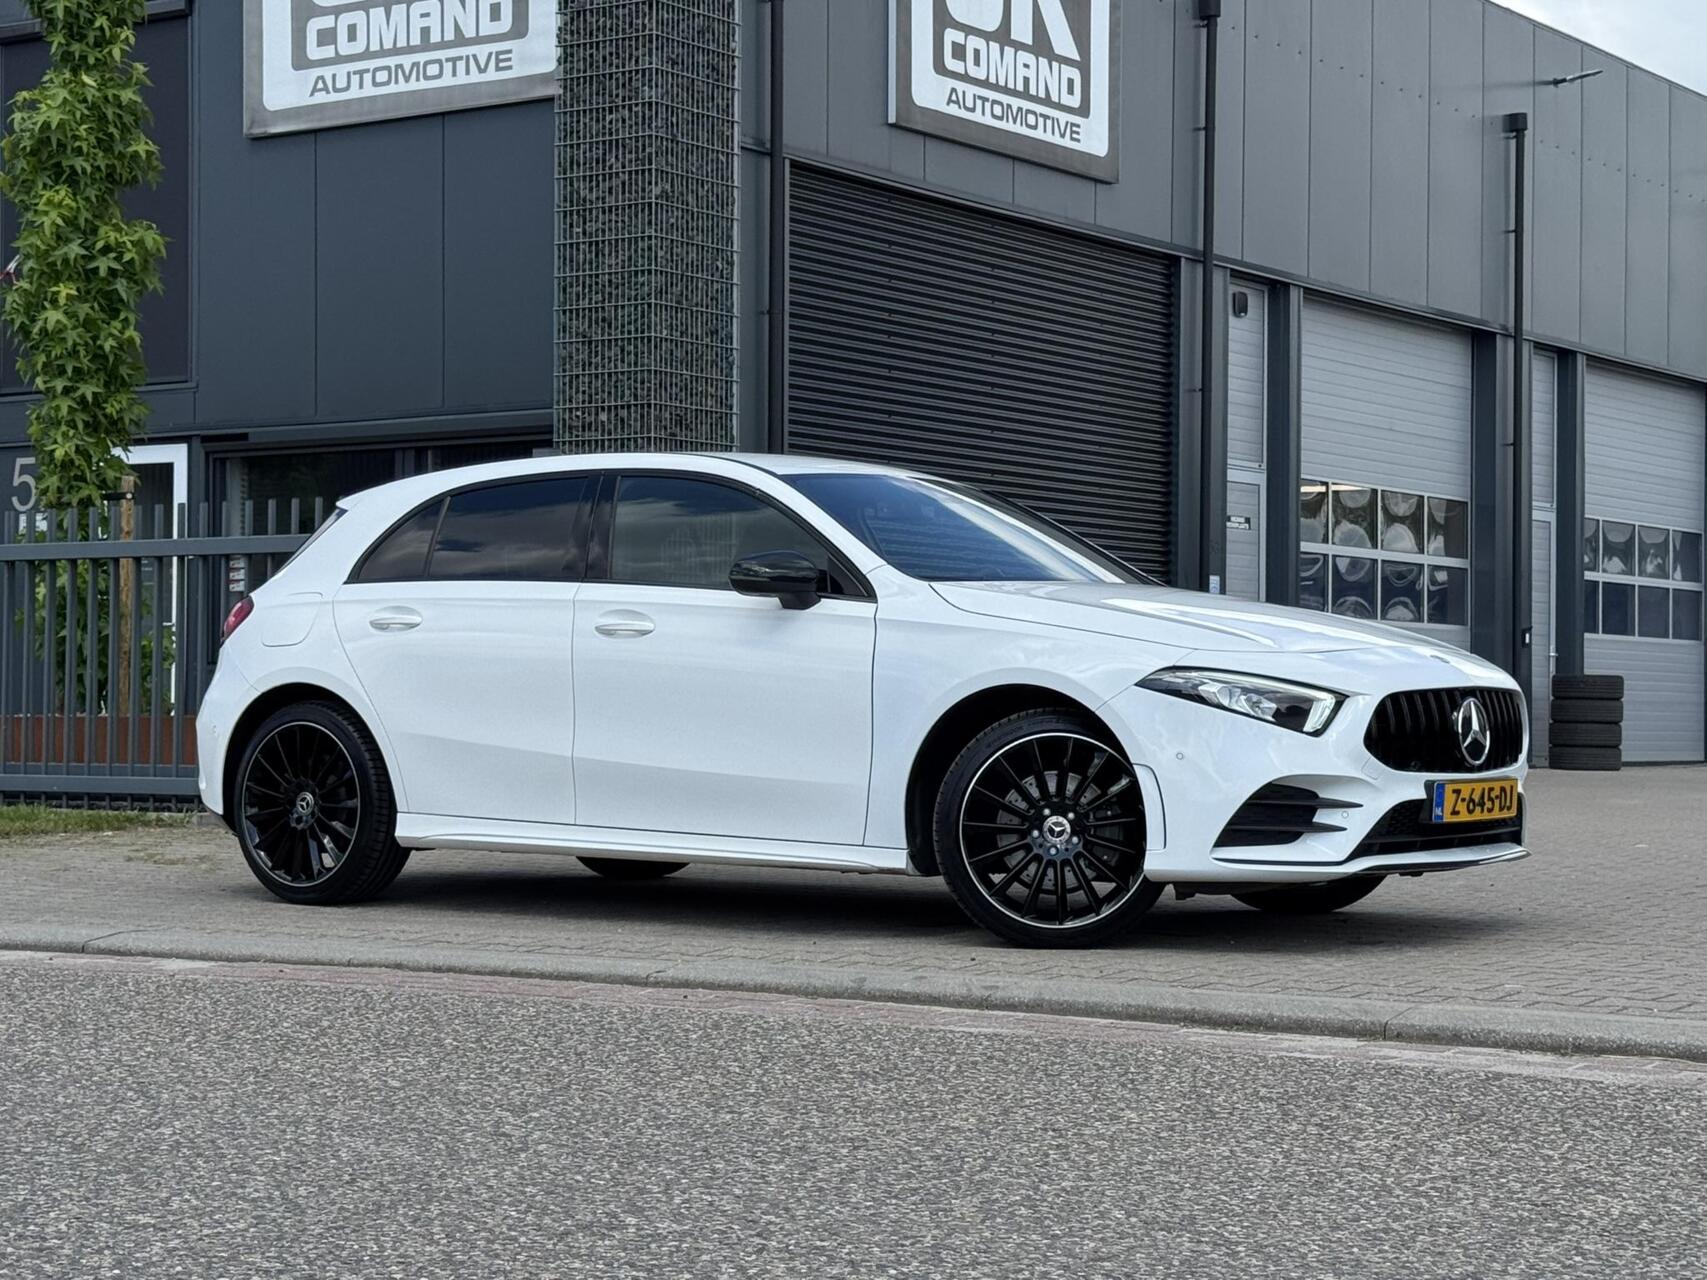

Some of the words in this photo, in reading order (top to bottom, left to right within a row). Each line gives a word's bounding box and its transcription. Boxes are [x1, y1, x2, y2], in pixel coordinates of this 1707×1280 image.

[307, 0, 513, 60] COMAND
[308, 49, 513, 97] AUTOMOTIVE
[944, 28, 1081, 109] COMAND
[946, 87, 1081, 143] AUTOMOTIVE
[11, 456, 36, 512] 5
[1450, 785, 1514, 816] Z-645-DJ
